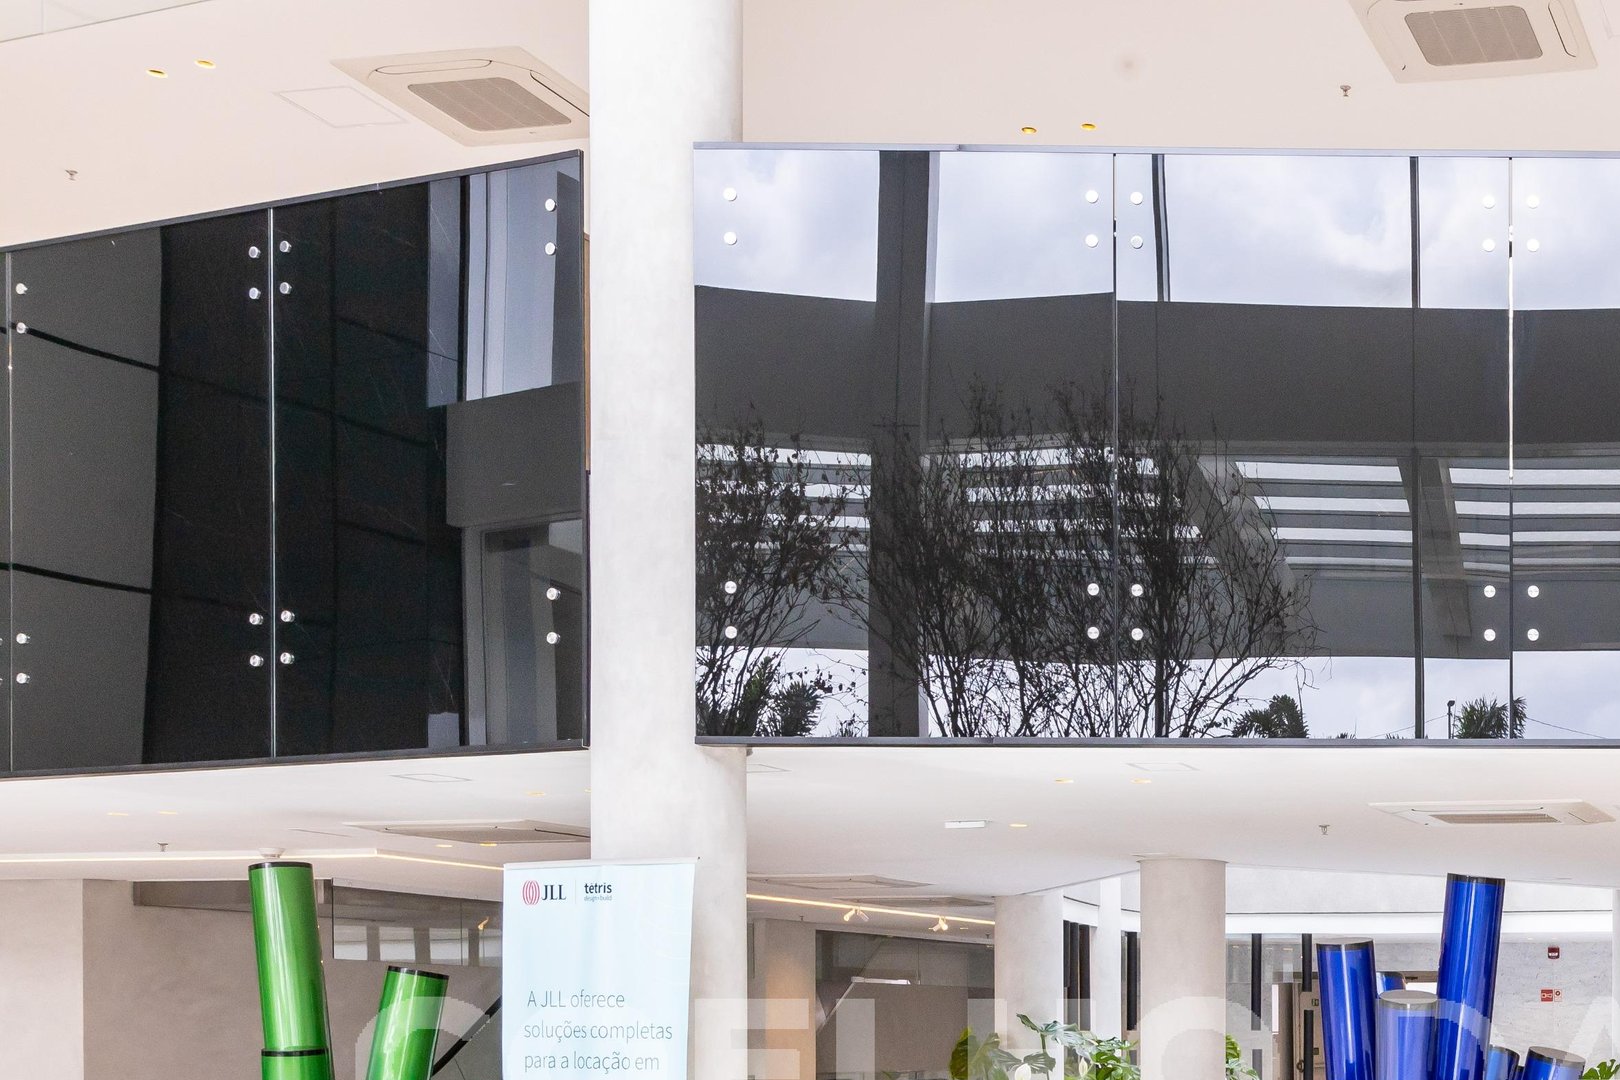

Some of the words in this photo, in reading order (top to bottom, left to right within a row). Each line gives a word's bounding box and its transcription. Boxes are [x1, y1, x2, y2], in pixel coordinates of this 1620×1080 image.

[541, 884, 567, 901] JLL
[527, 990, 537, 1008] A
[540, 990, 566, 1008] JLL
[570, 989, 625, 1008] oferece
[524, 1019, 587, 1043] soluções
[590, 1020, 673, 1044] completas
[524, 1054, 556, 1073] para
[560, 1055, 569, 1069] a
[573, 1050, 631, 1074] locação
[634, 1056, 660, 1070] em
